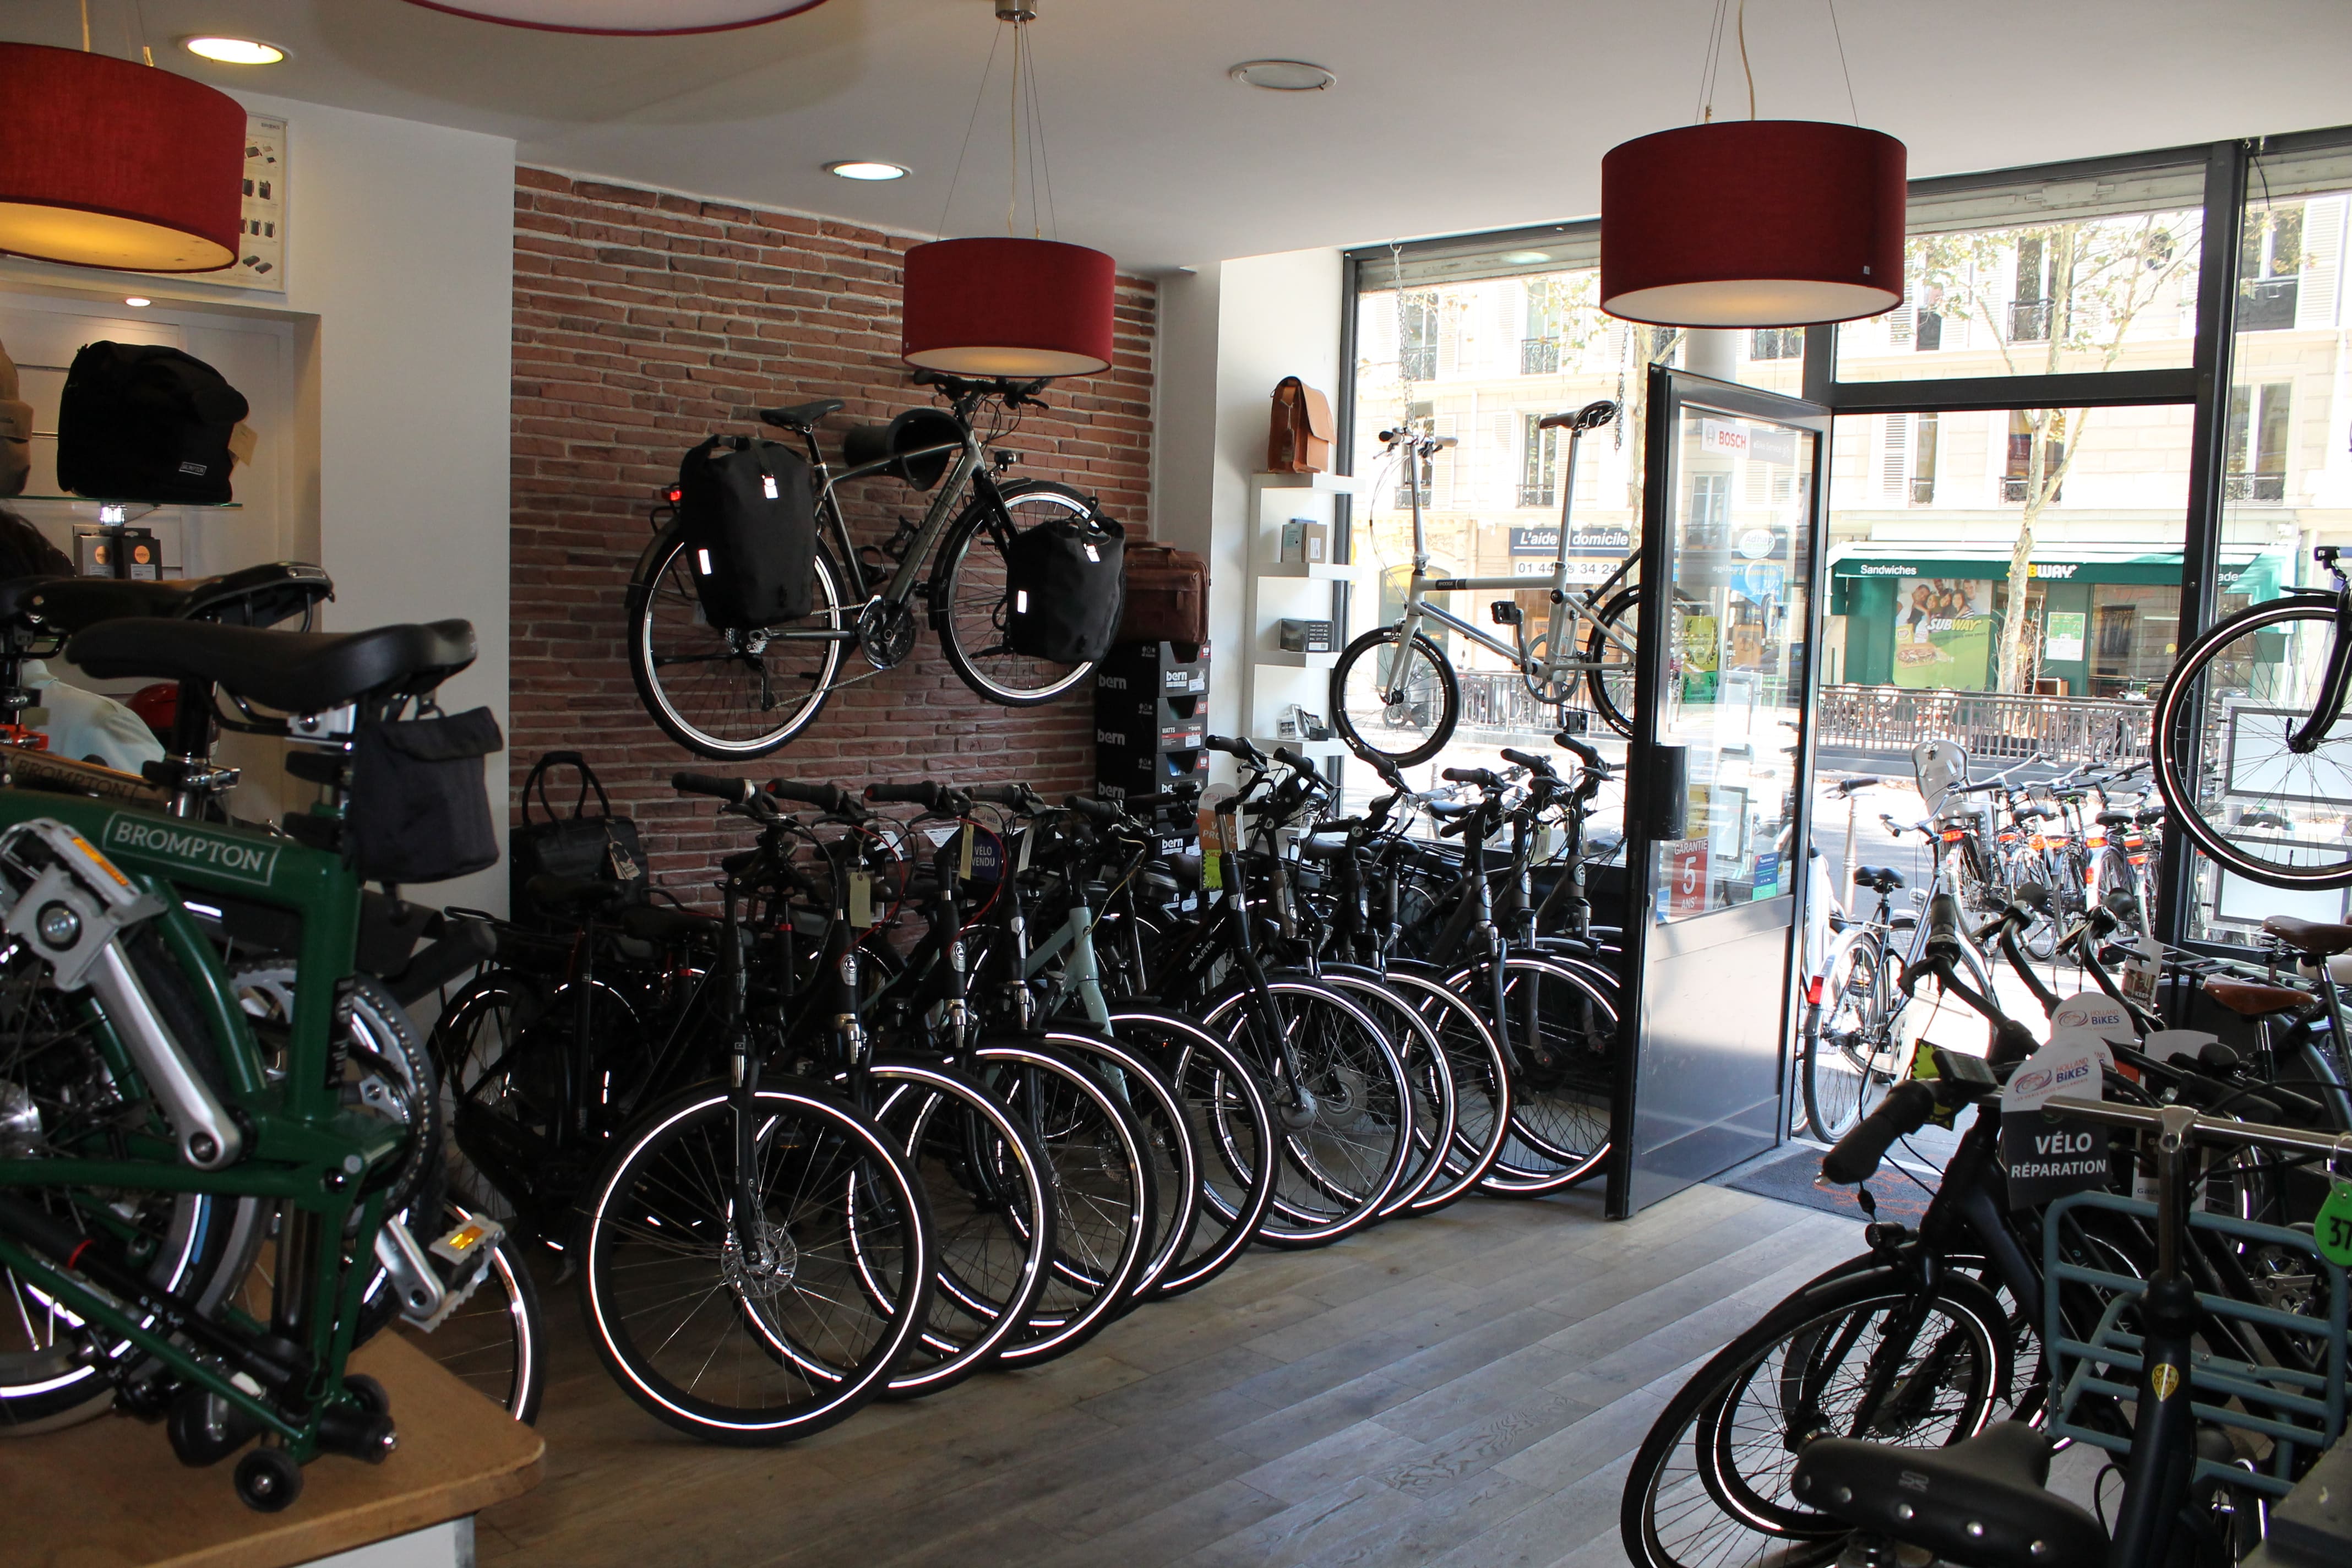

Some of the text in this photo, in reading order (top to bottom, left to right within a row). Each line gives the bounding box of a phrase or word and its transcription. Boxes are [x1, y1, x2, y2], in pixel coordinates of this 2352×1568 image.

[1719, 431, 1746, 450] BOSCH
[1520, 532, 1629, 546] L'aide domicile
[1745, 534, 1773, 545] Adhap
[1518, 563, 1533, 573] 01
[1538, 563, 1556, 574] 44
[1580, 563, 1596, 574] 34
[1601, 564, 1618, 574] 24
[1861, 564, 1917, 575] Sandwiches
[1927, 618, 1982, 631] SUBWAY
[1098, 674, 1127, 690] bern
[1166, 671, 1188, 682] bern
[1097, 728, 1125, 745] bern
[15, 759, 129, 798] BROMPTON
[1098, 782, 1125, 798] bern
[1161, 783, 1173, 793] be
[1211, 821, 1236, 833] VO
[1202, 830, 1238, 843] PROO
[114, 822, 264, 872] BROMPTON
[974, 845, 992, 856] VÉLO
[1162, 838, 1183, 850] bern
[1674, 838, 1707, 855] GARANTIE
[971, 857, 995, 867] VENDU
[1683, 856, 1696, 895] 5
[1188, 940, 1215, 971] SPARTA
[2056, 1057, 2088, 1072] HOLLAND
[2035, 1130, 2092, 1155] VÉLO
[2011, 1159, 2106, 1178] RÉPARATION
